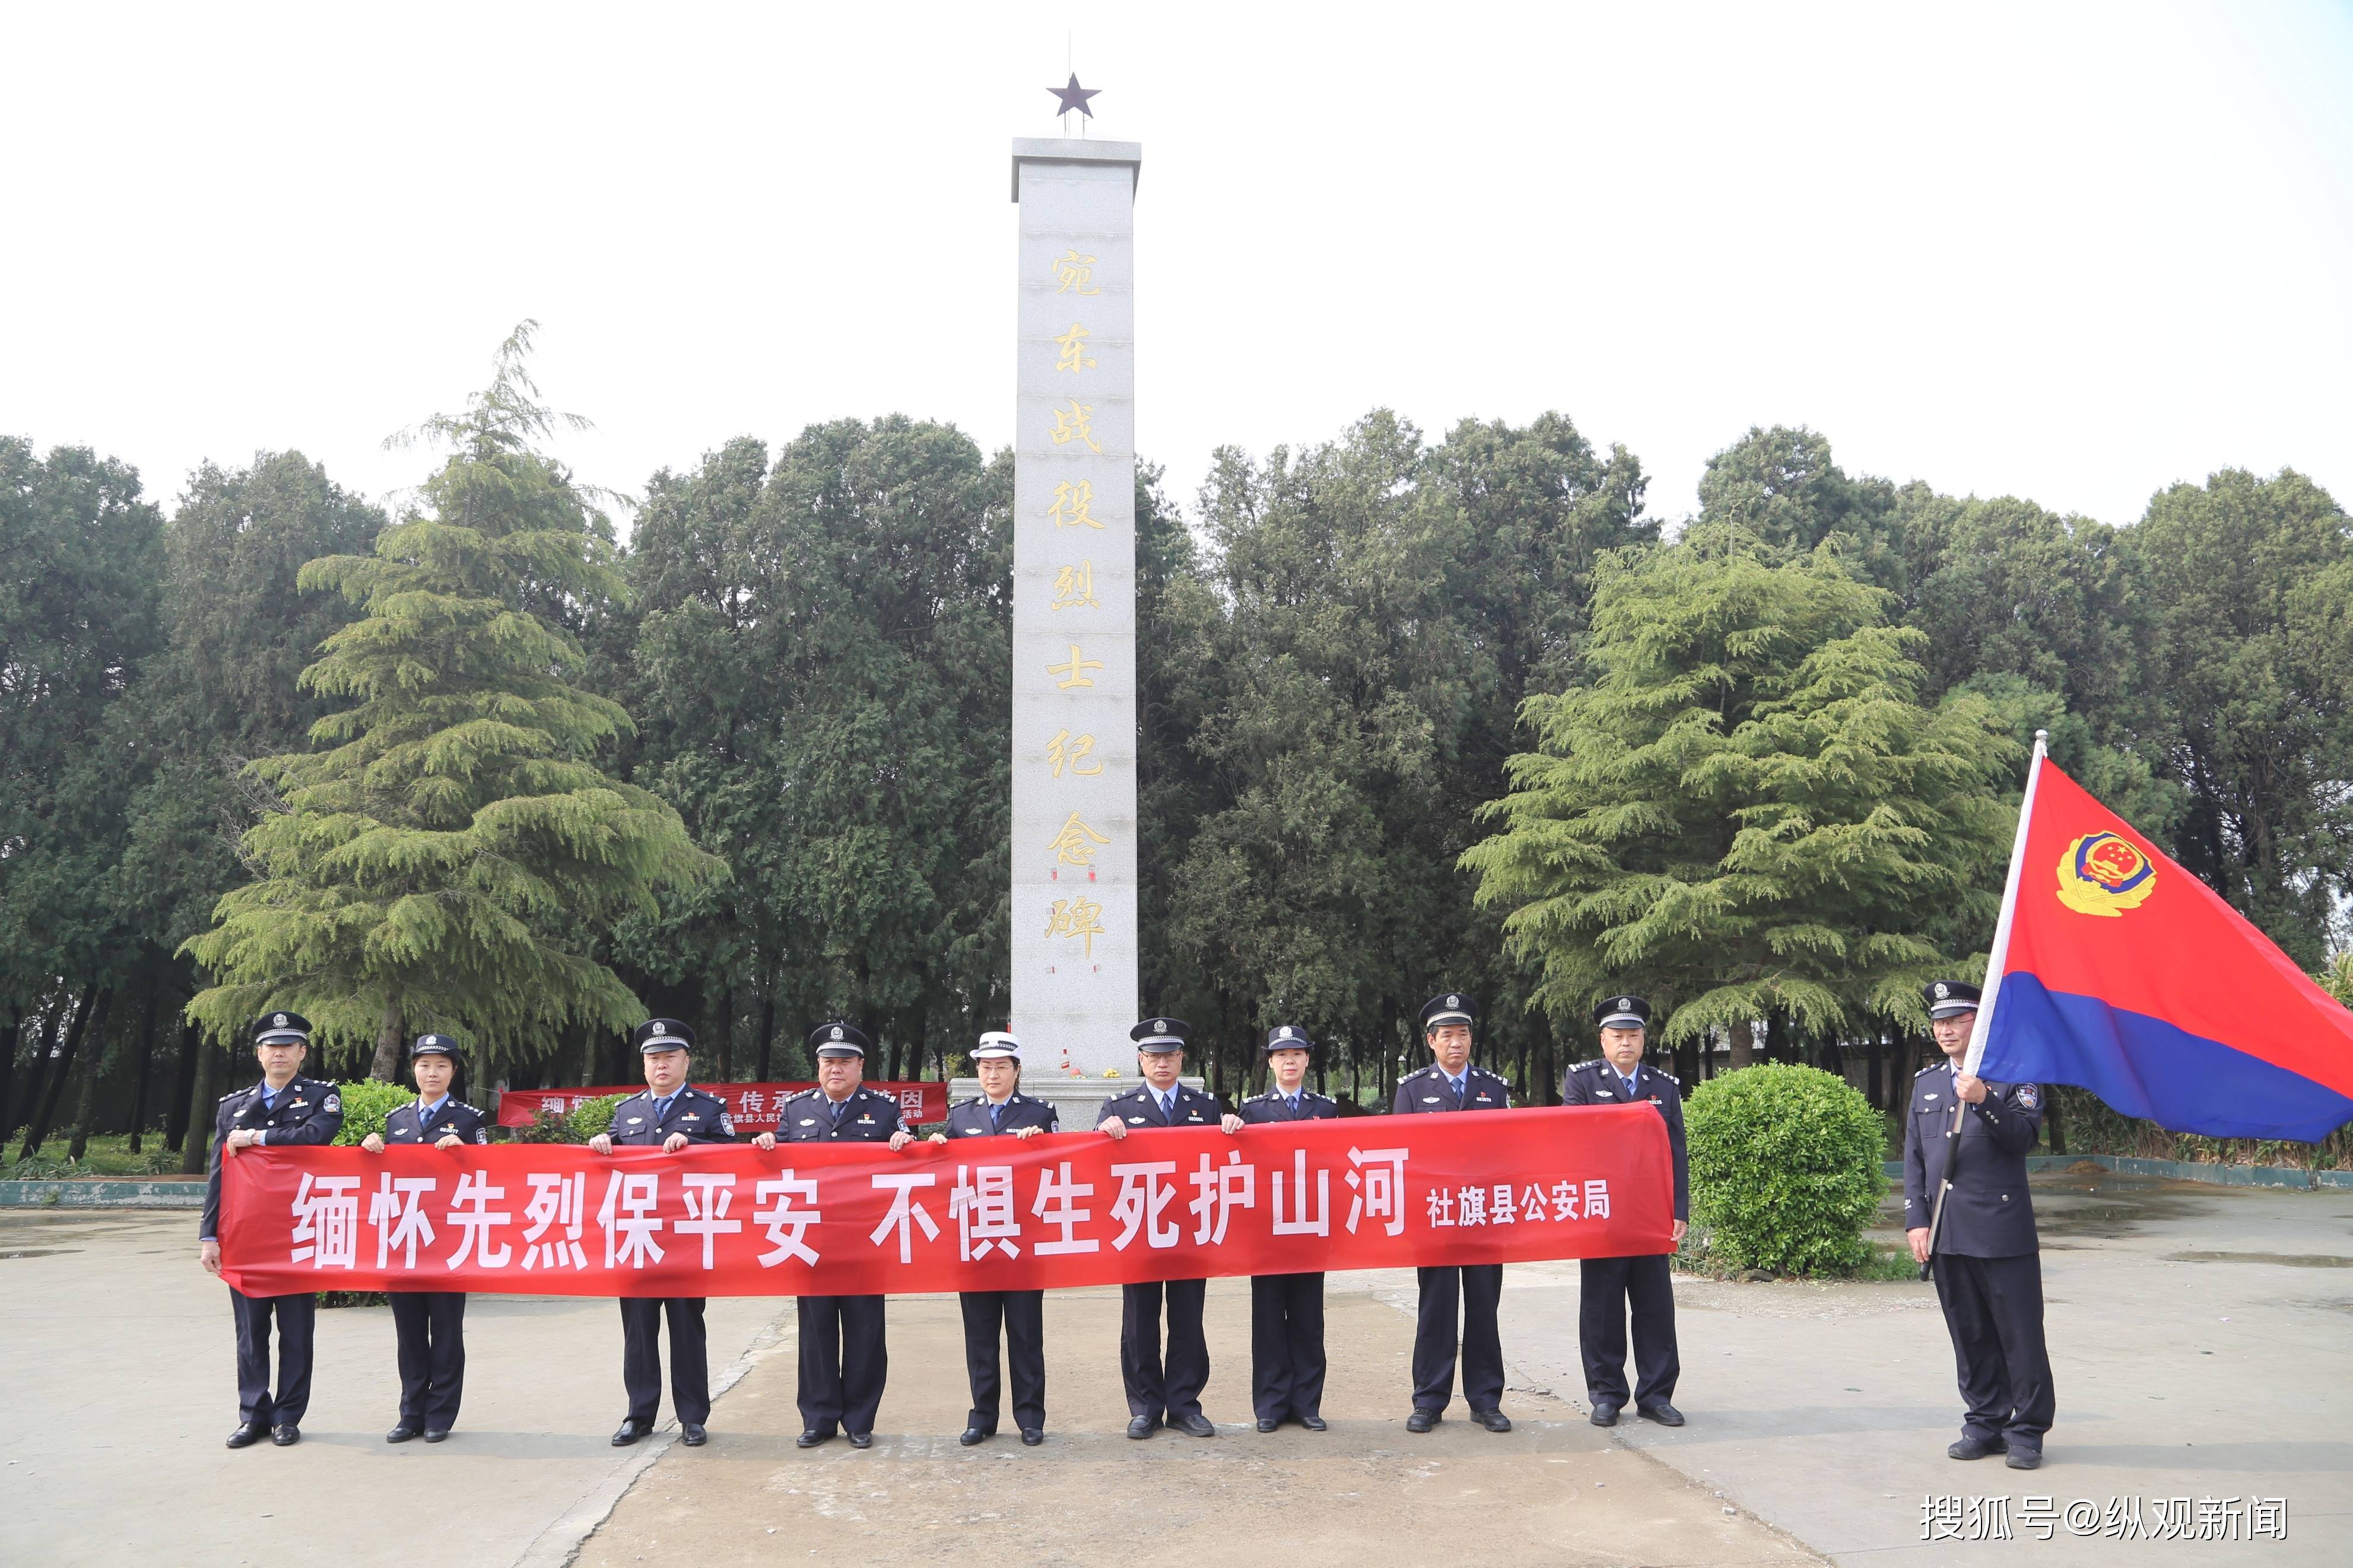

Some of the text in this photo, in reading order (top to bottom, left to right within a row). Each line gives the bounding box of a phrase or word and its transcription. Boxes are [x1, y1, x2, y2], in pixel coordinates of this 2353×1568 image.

[1044, 249, 1112, 959] 宛东战役烈士纪念碑
[900, 1089, 923, 1109] 因
[903, 1109, 923, 1118] 活动
[291, 1146, 1410, 1271] 缅怀先烈保平安 不惧生死护山河
[1425, 1179, 1611, 1228] 社旗县公安局
